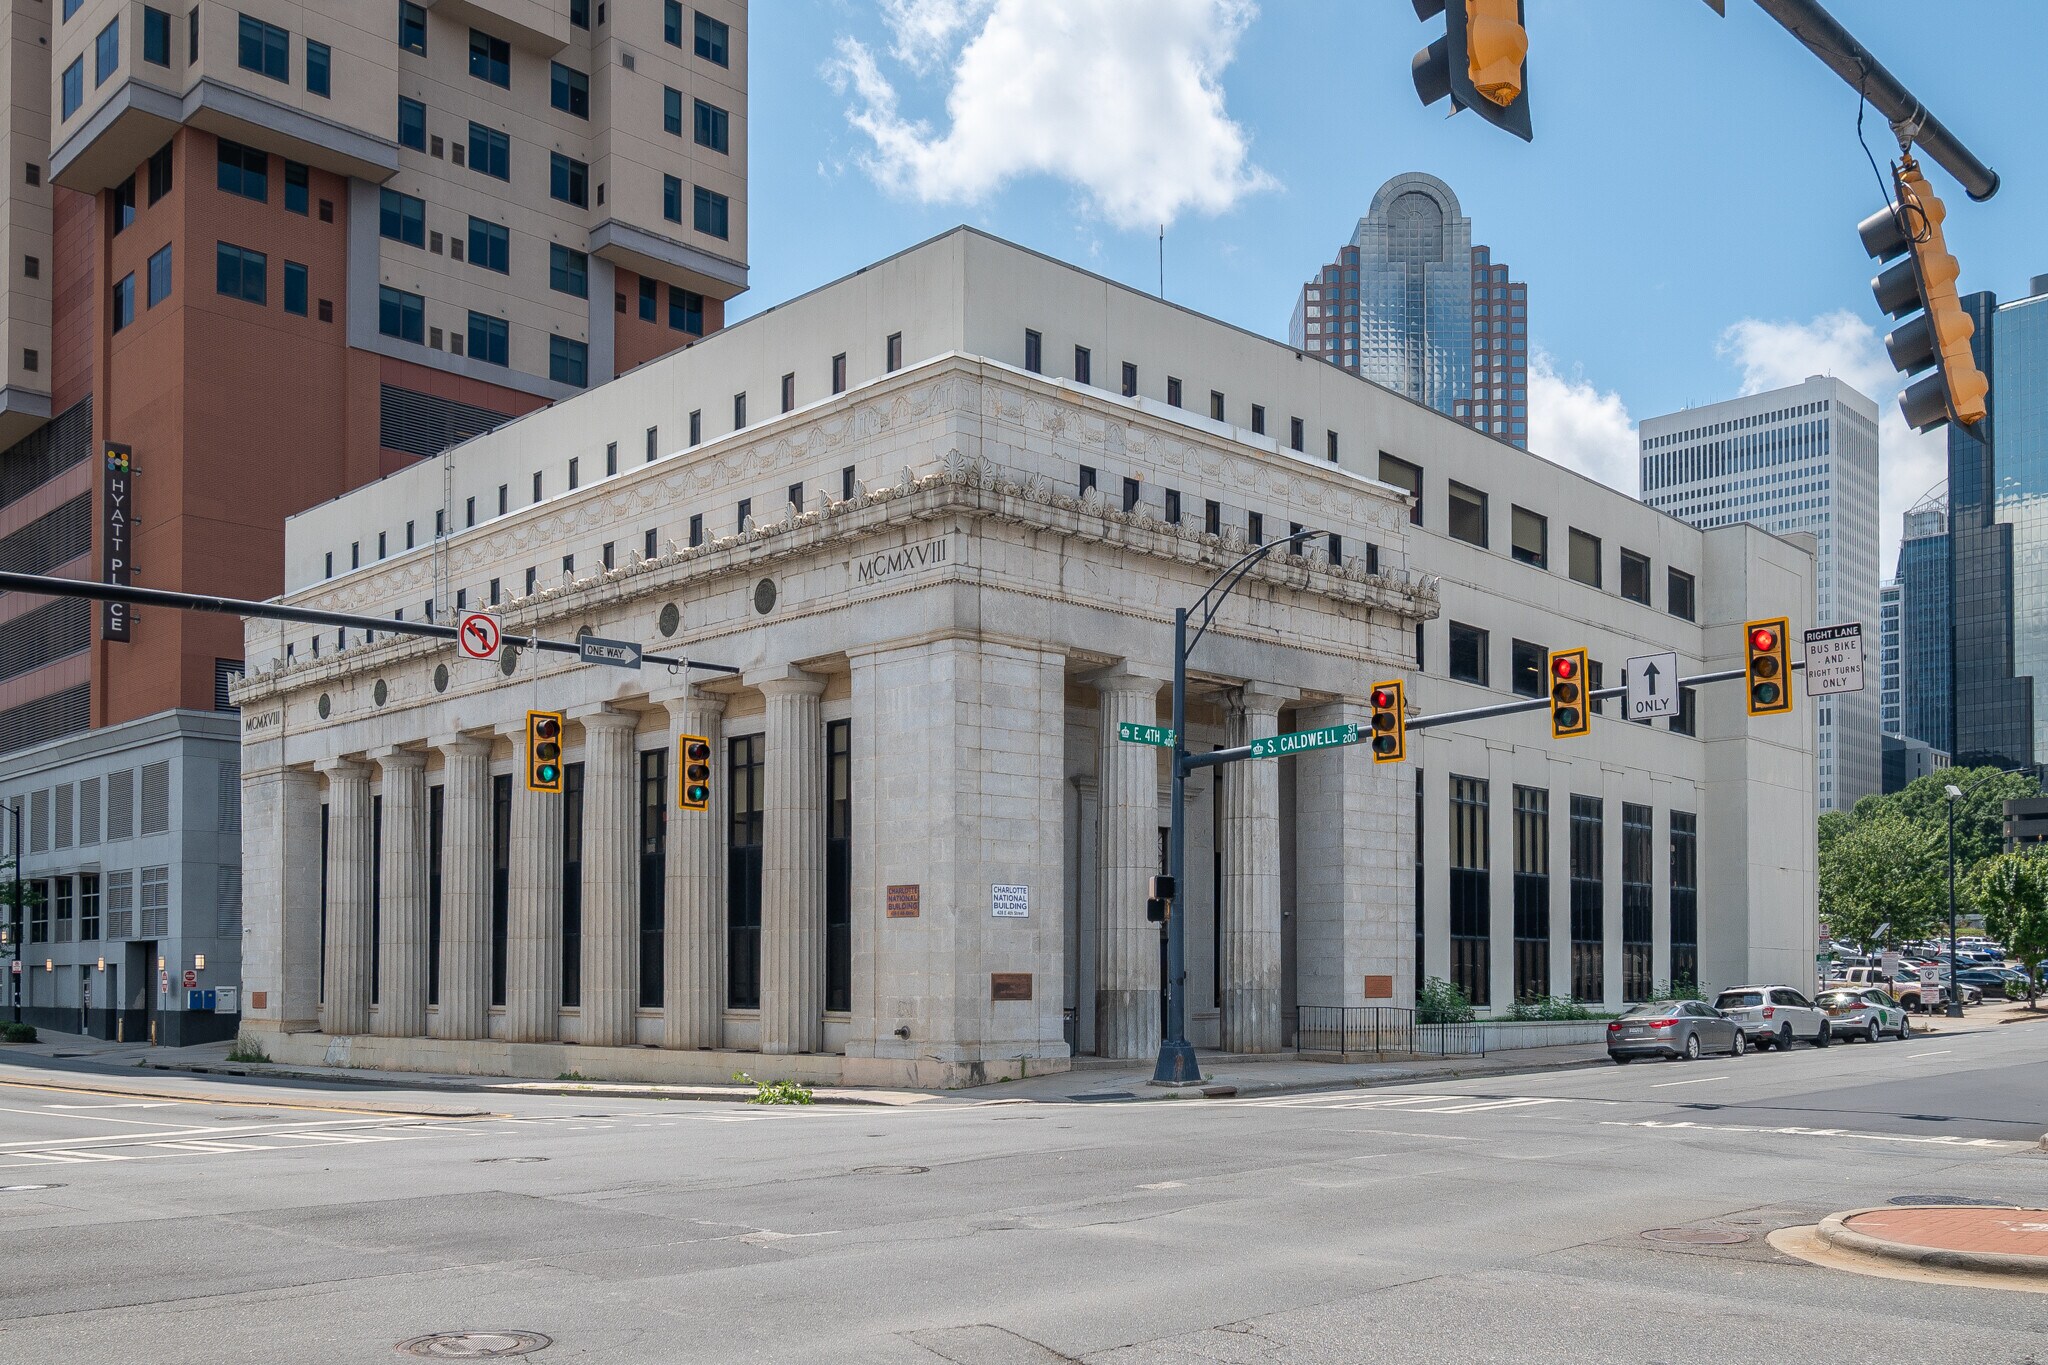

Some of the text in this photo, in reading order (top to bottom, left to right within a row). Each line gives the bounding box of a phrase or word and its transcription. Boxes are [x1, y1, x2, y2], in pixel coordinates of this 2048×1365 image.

[111, 478, 125, 631] HYATT PLCE
[858, 539, 947, 582] MCMXVIII
[1807, 626, 1858, 641] RIGHT LANE
[587, 645, 625, 659] ONE WAY
[1811, 641, 1856, 654] BUS BIKE
[1825, 654, 1843, 664] AND
[1808, 665, 1860, 678] RIGHT TURNS
[1823, 678, 1847, 688] ONLY
[1636, 697, 1670, 714] ONLY
[246, 710, 280, 732] MCMXVIII
[1133, 726, 1160, 743] E. 4TH
[1168, 729, 1174, 739] ST
[1347, 723, 1356, 734] ST
[1267, 729, 1339, 754] S. CALDWELL
[1342, 732, 1357, 744] 200
[993, 886, 1027, 895] CHARLOTTE
[993, 894, 1027, 902] NATIONAL
[888, 902, 918, 911] BUILDING
[993, 902, 1027, 910] BUILDING
